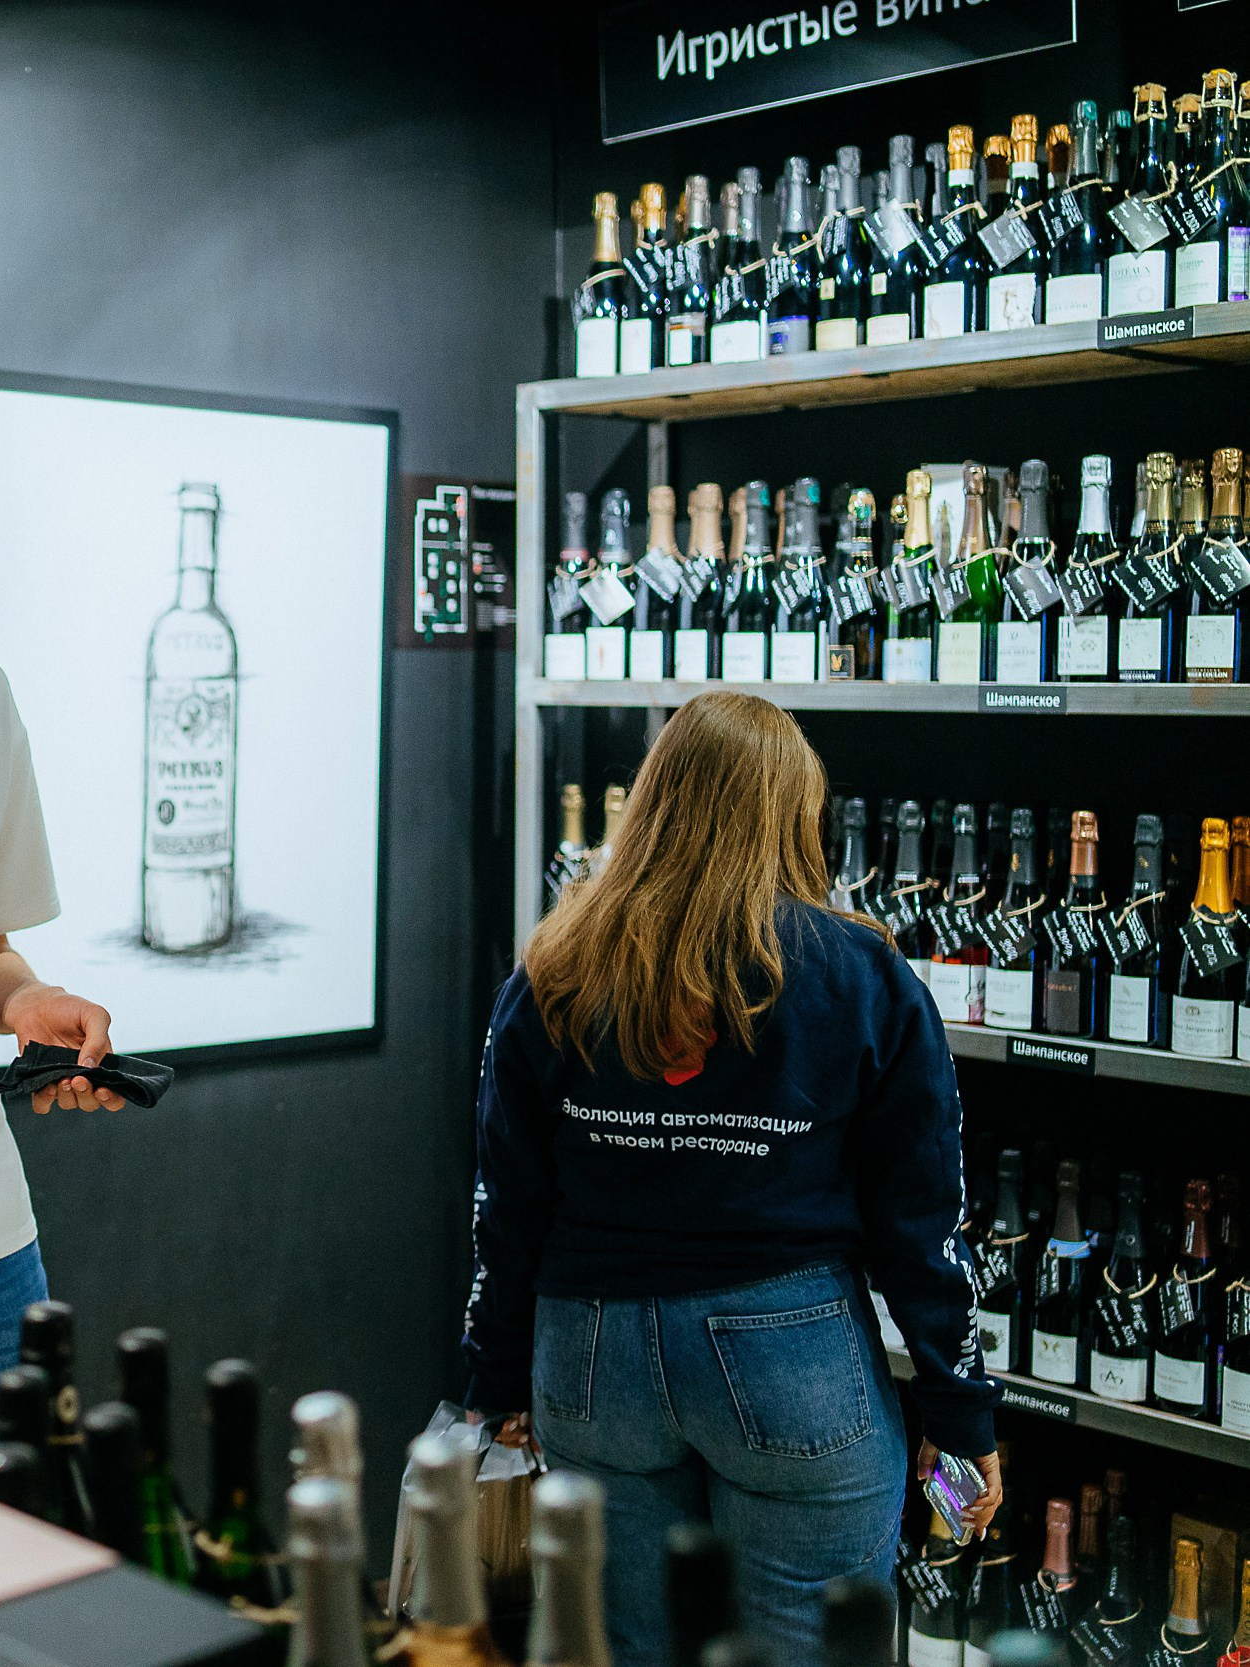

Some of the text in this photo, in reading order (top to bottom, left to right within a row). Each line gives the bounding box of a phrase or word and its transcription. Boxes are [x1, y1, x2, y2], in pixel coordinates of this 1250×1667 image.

[658, 0, 857, 80] Игристые
[1105, 319, 1185, 340] Шампанское
[986, 692, 1060, 707] Шампанское
[1013, 1040, 1088, 1065] Шампанское
[561, 1098, 812, 1135] Эволюция автоматизации
[589, 1132, 770, 1157] в твоем ресторане
